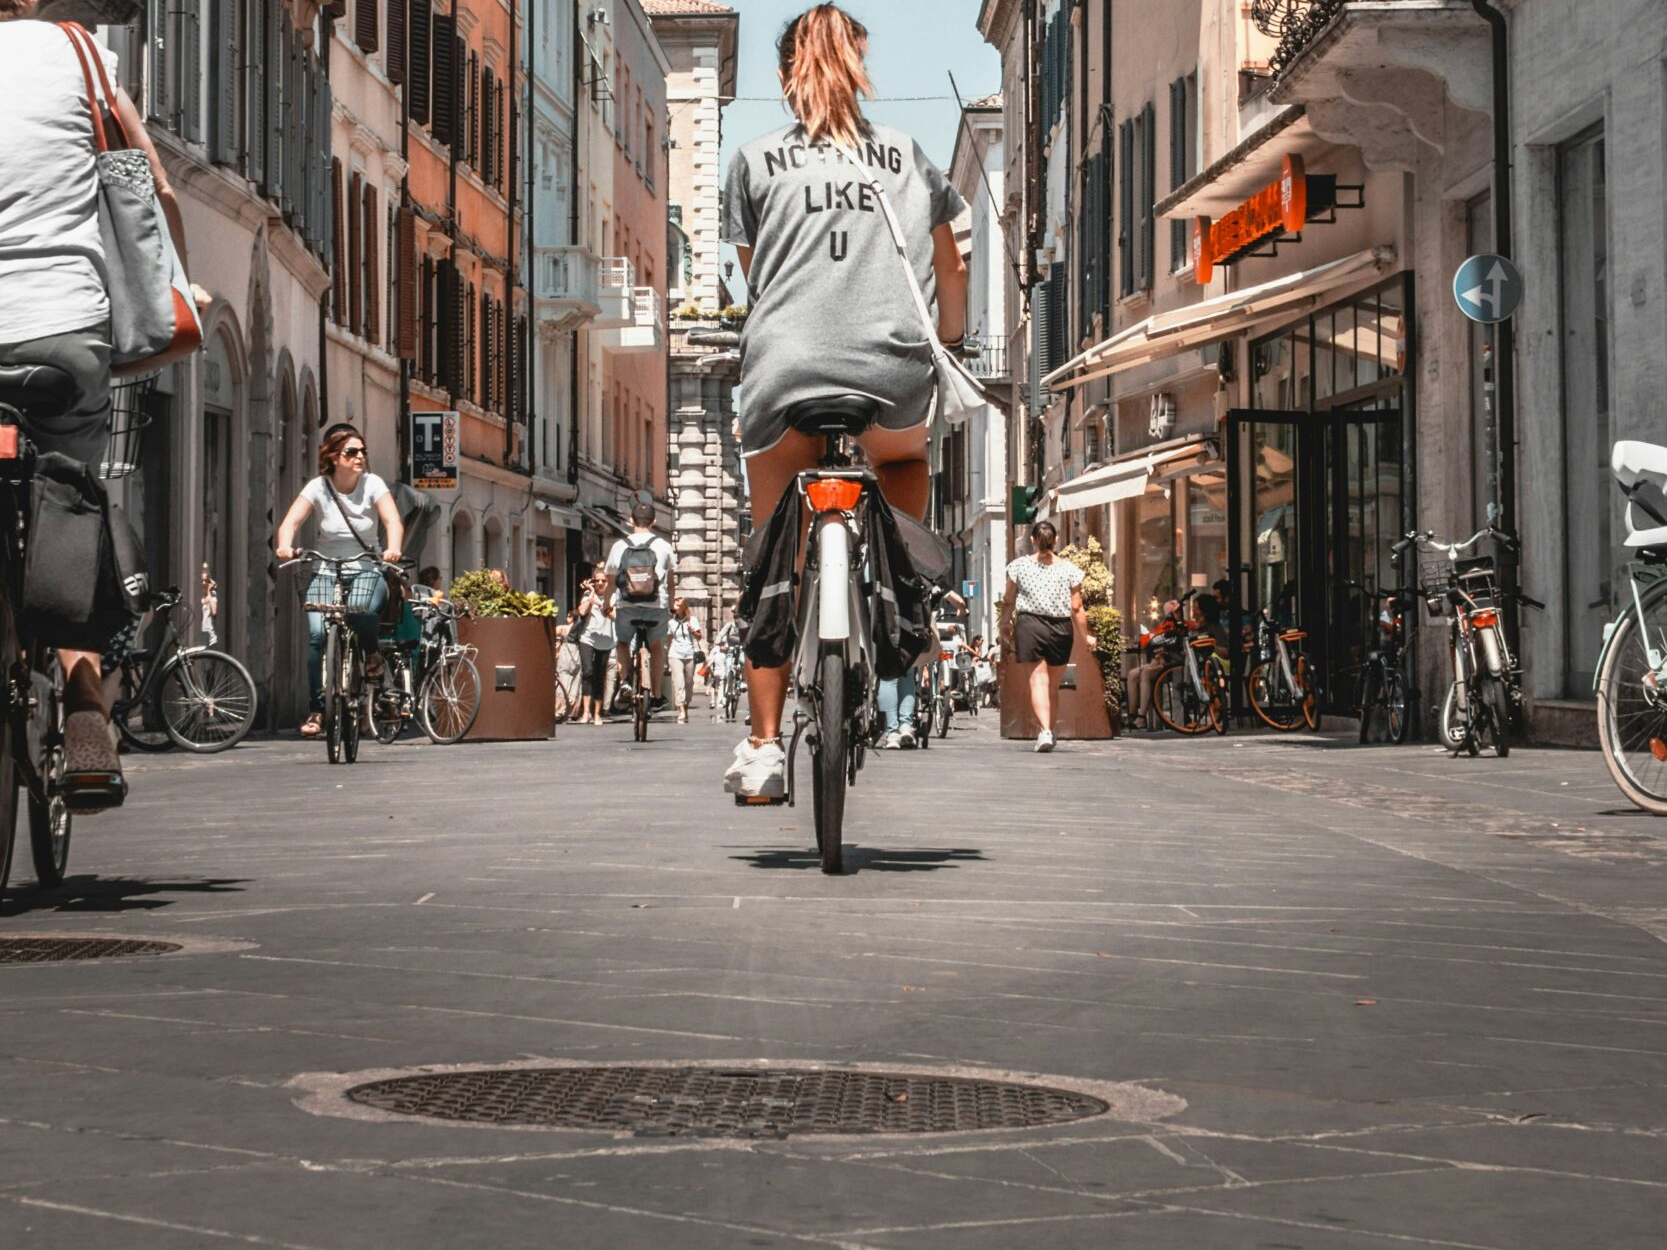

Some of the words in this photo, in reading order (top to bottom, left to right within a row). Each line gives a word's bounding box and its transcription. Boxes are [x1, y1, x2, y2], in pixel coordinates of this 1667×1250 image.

[804, 181, 876, 214] LIKE
[829, 231, 848, 262] U
[415, 416, 441, 452] T
[444, 417, 456, 463] LOTTO
